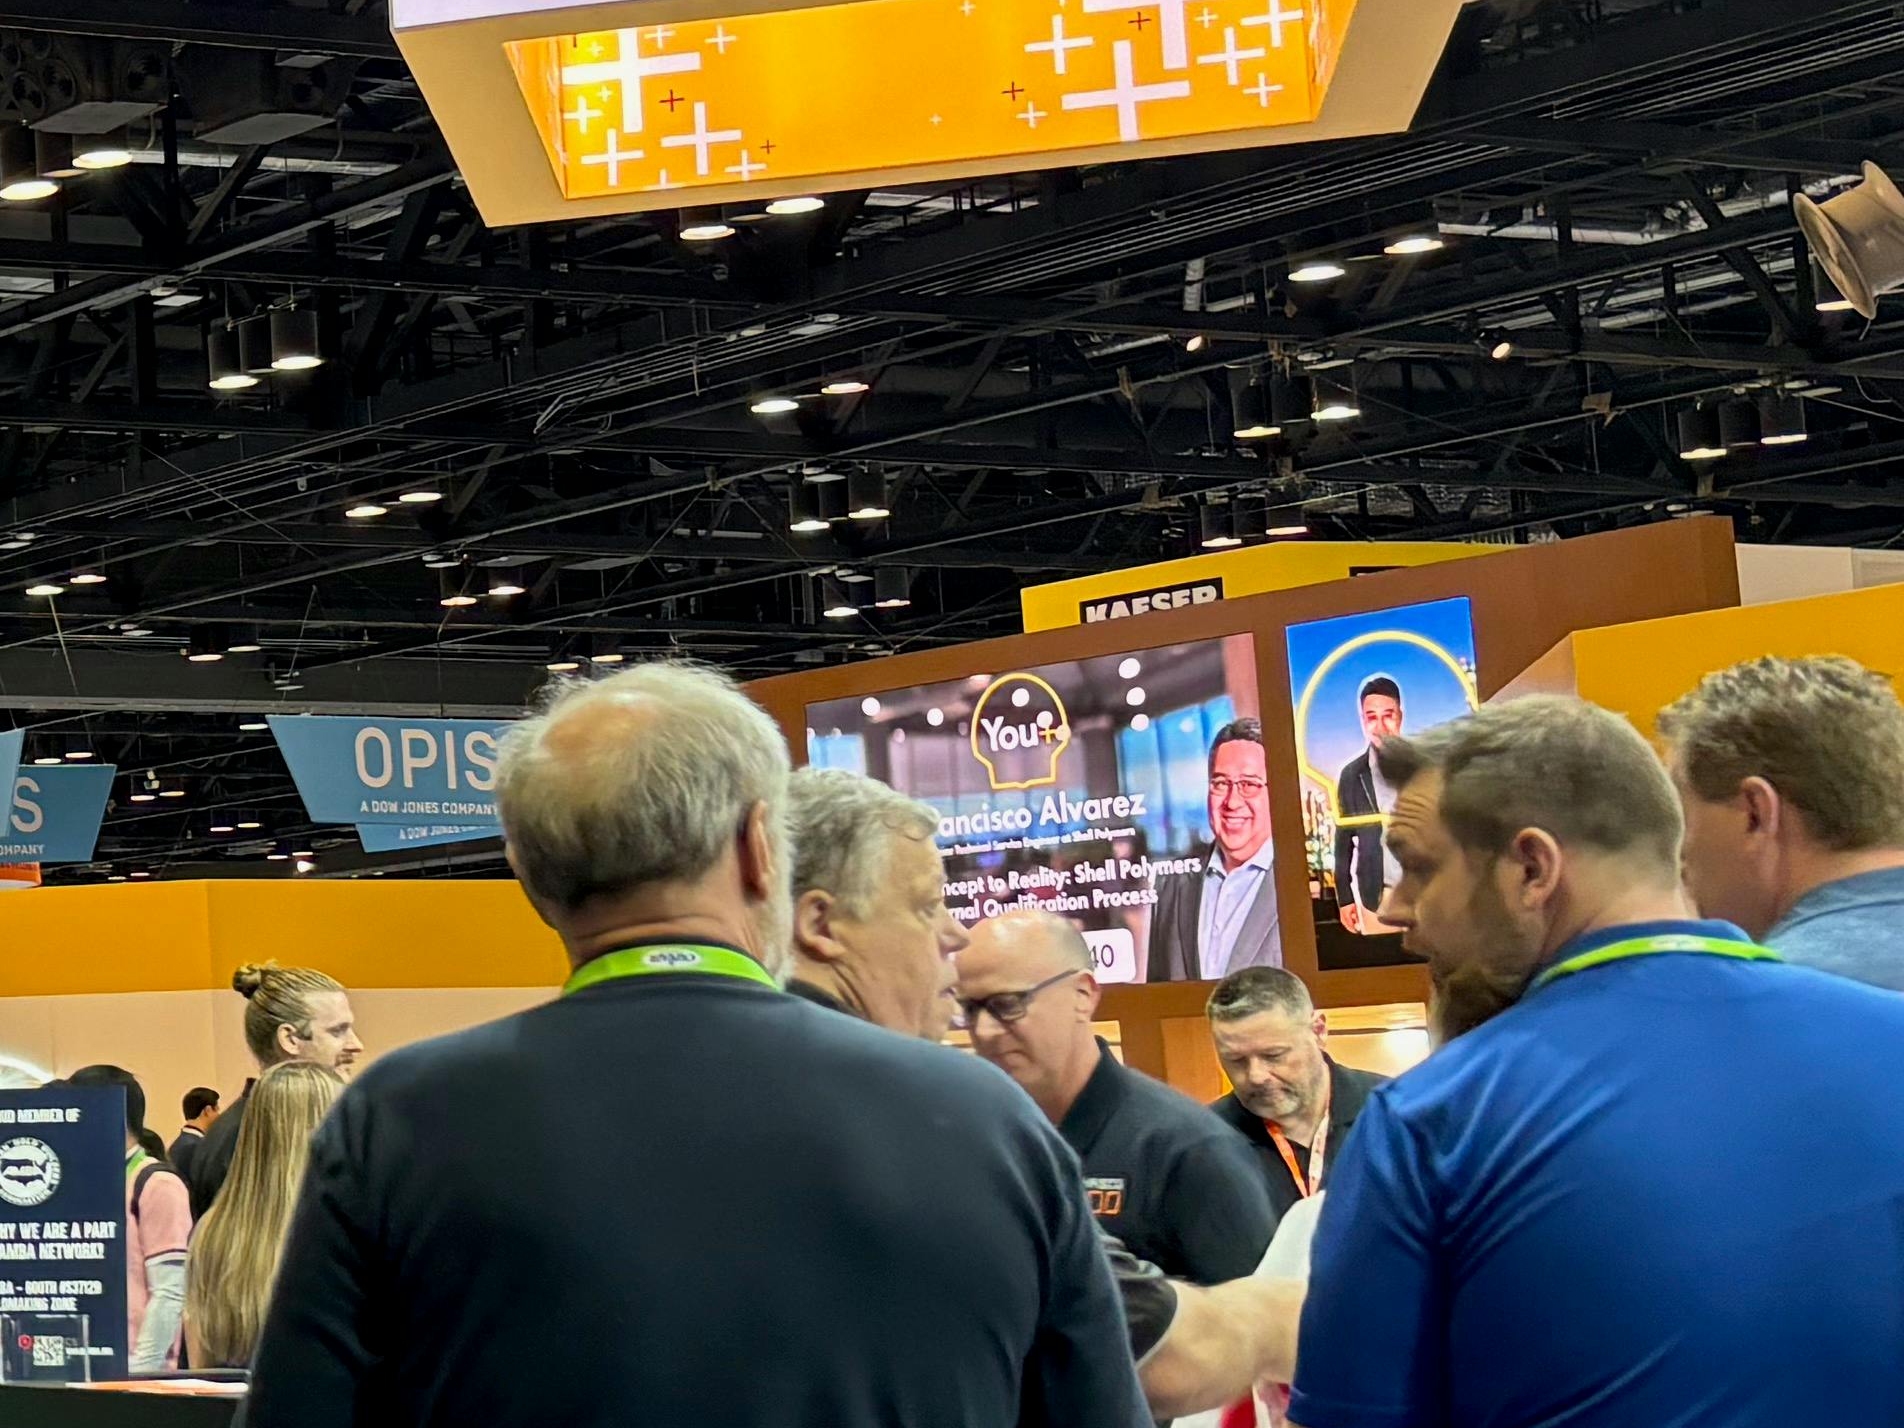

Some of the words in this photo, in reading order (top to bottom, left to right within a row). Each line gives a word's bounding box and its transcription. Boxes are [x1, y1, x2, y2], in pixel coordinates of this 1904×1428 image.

[355, 727, 496, 791] OPIS
[361, 800, 369, 812] A
[372, 801, 397, 812] DOW
[401, 801, 439, 814] JONES
[442, 802, 498, 815] COMPANY
[938, 803, 1032, 838] ancisco
[1039, 790, 1147, 827] Alvarez
[942, 875, 984, 897] ncept
[988, 875, 1004, 893] to
[1008, 867, 1071, 892] Reality:
[1075, 859, 1117, 884] Shell
[1120, 855, 1201, 883] Polymers
[1092, 886, 1158, 910] Process
[19, 1222, 40, 1239] WE
[43, 1222, 68, 1239] ARE
[71, 1222, 81, 1239] A
[84, 1222, 117, 1239] PART
